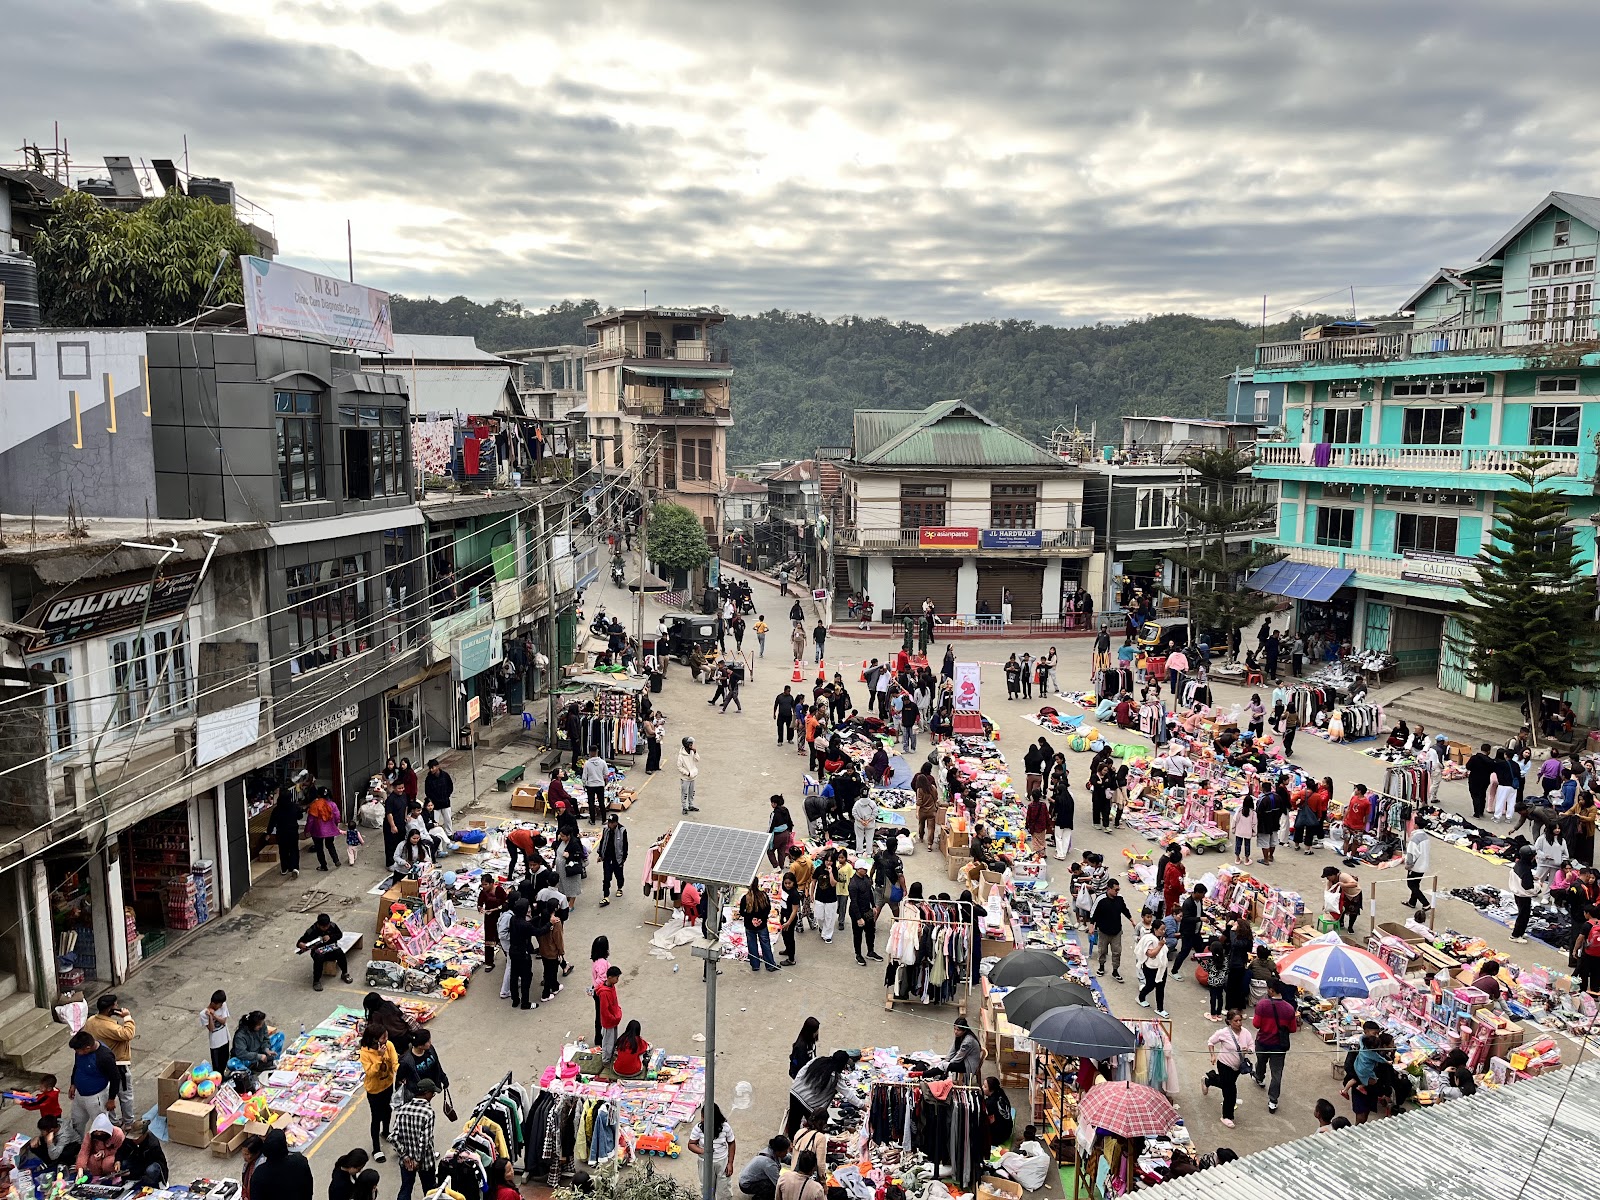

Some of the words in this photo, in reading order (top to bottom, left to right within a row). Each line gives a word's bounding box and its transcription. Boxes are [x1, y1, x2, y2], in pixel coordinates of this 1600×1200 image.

[314, 276, 323, 294] M
[325, 281, 331, 296] &
[333, 282, 340, 298] D
[294, 292, 309, 306] Clinic
[309, 295, 320, 308] Cum
[321, 298, 346, 313] Diagnostic
[346, 302, 361, 316] Centre
[937, 530, 969, 540] asianpaints
[1423, 562, 1462, 577] CALITUS
[48, 583, 151, 623] CALITUS
[299, 709, 349, 737] PHARMACY
[1328, 976, 1359, 984] AIRCEL
